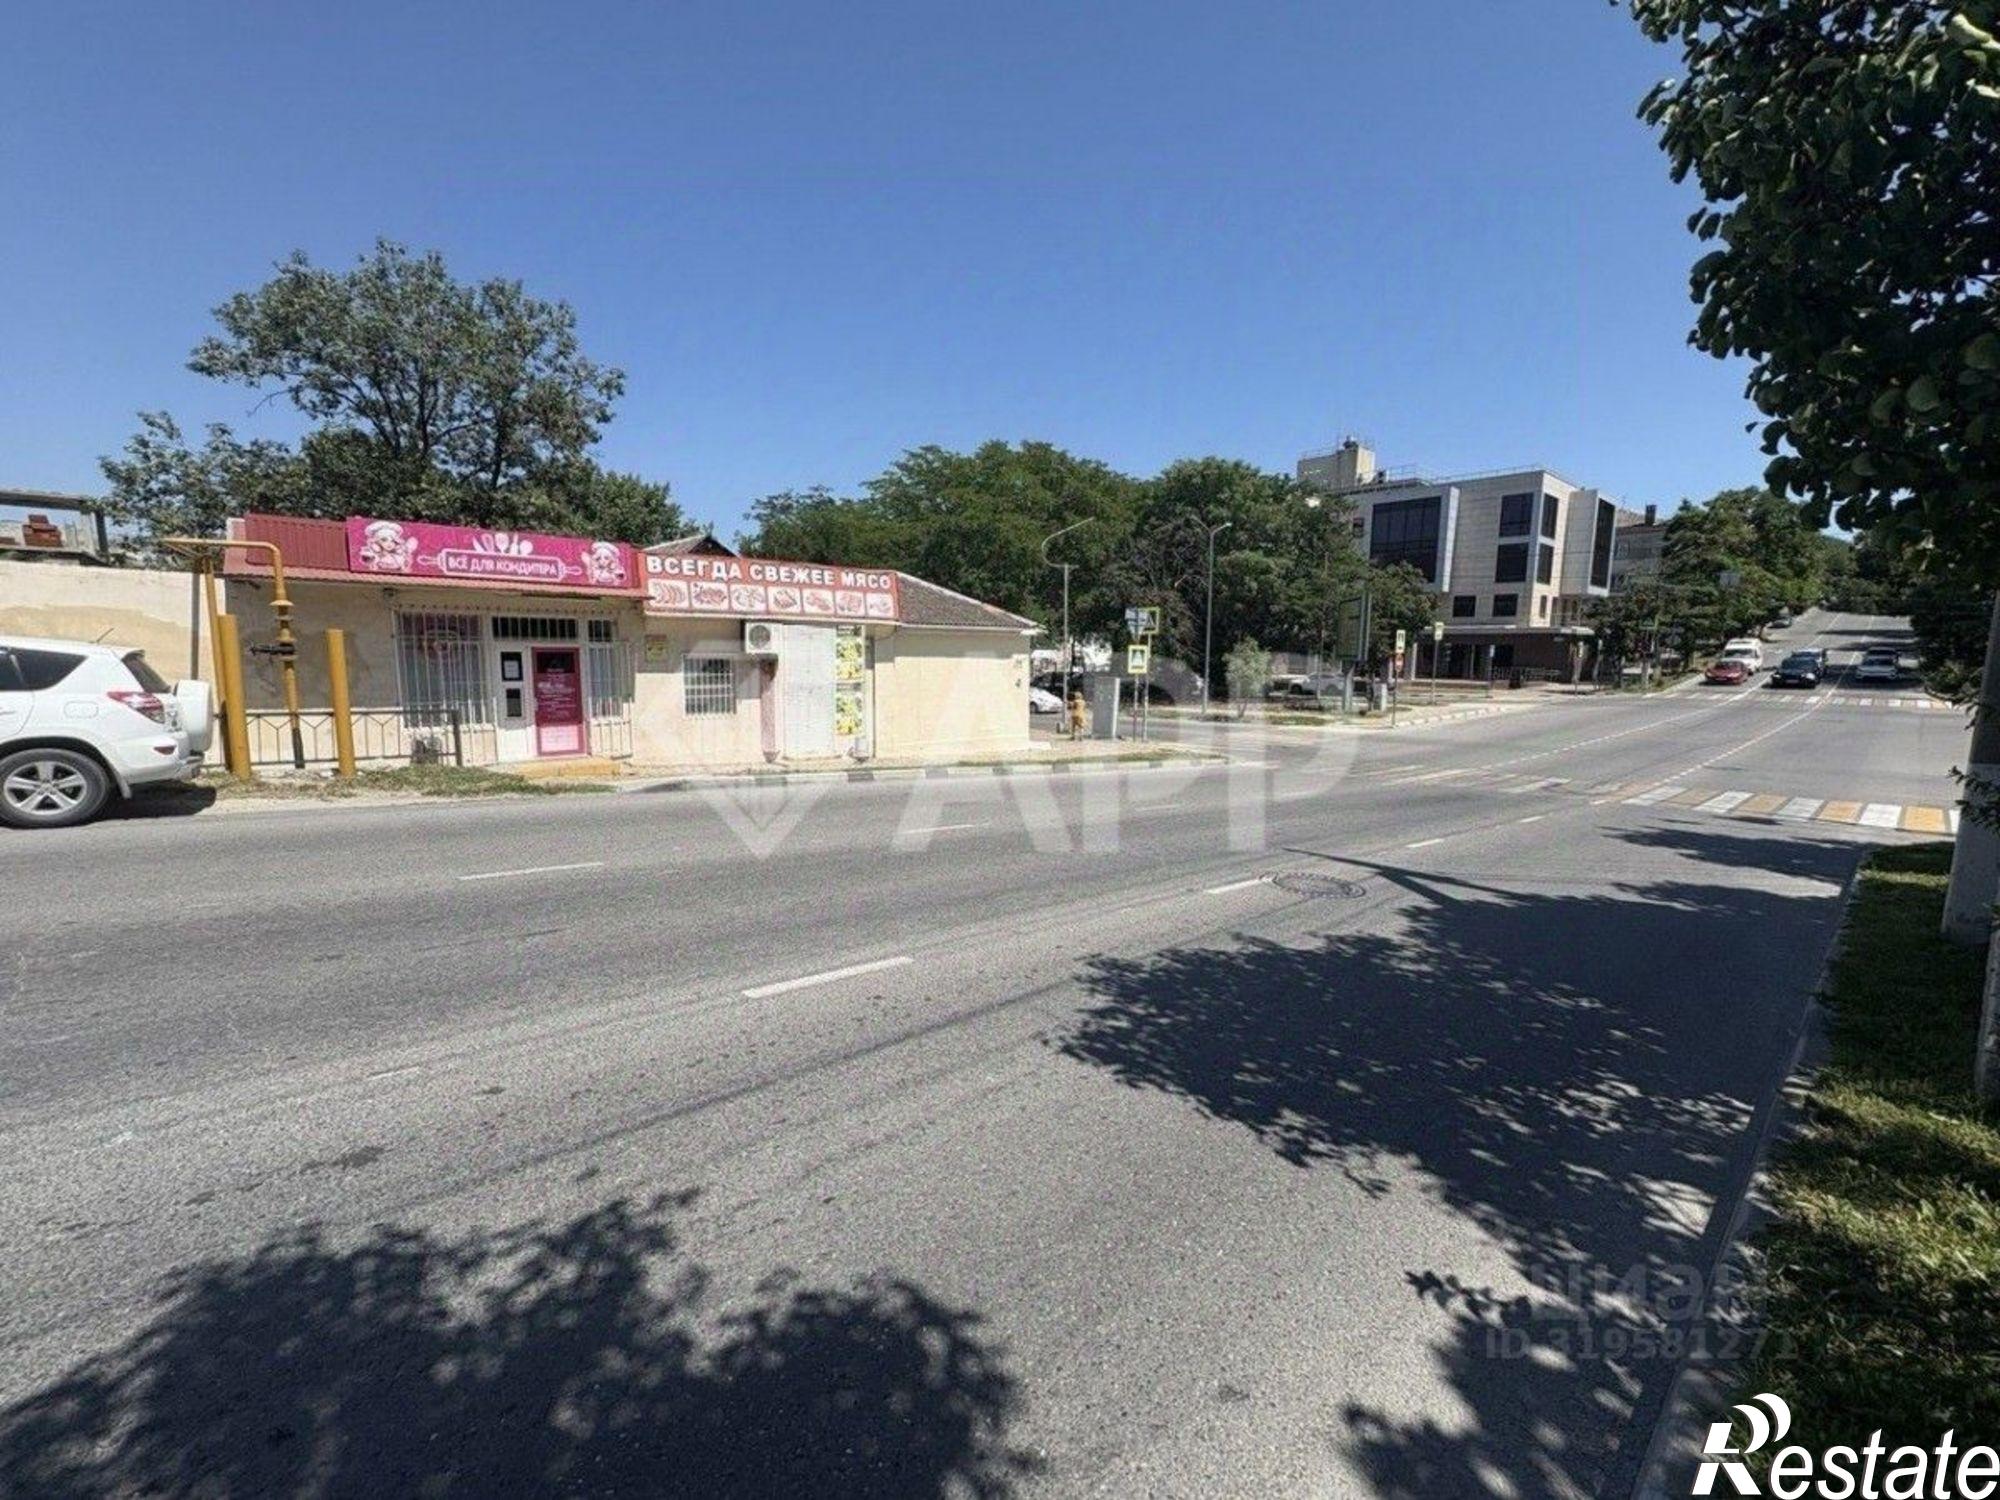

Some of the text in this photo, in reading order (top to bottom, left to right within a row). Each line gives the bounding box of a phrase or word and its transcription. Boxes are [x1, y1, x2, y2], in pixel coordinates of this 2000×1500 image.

[470, 558, 495, 572] ДЛЯ
[496, 559, 559, 577] КОНДИТЕРА
[646, 555, 892, 590] ВСЕГДА СВЕЖЕЕ МЯСО
